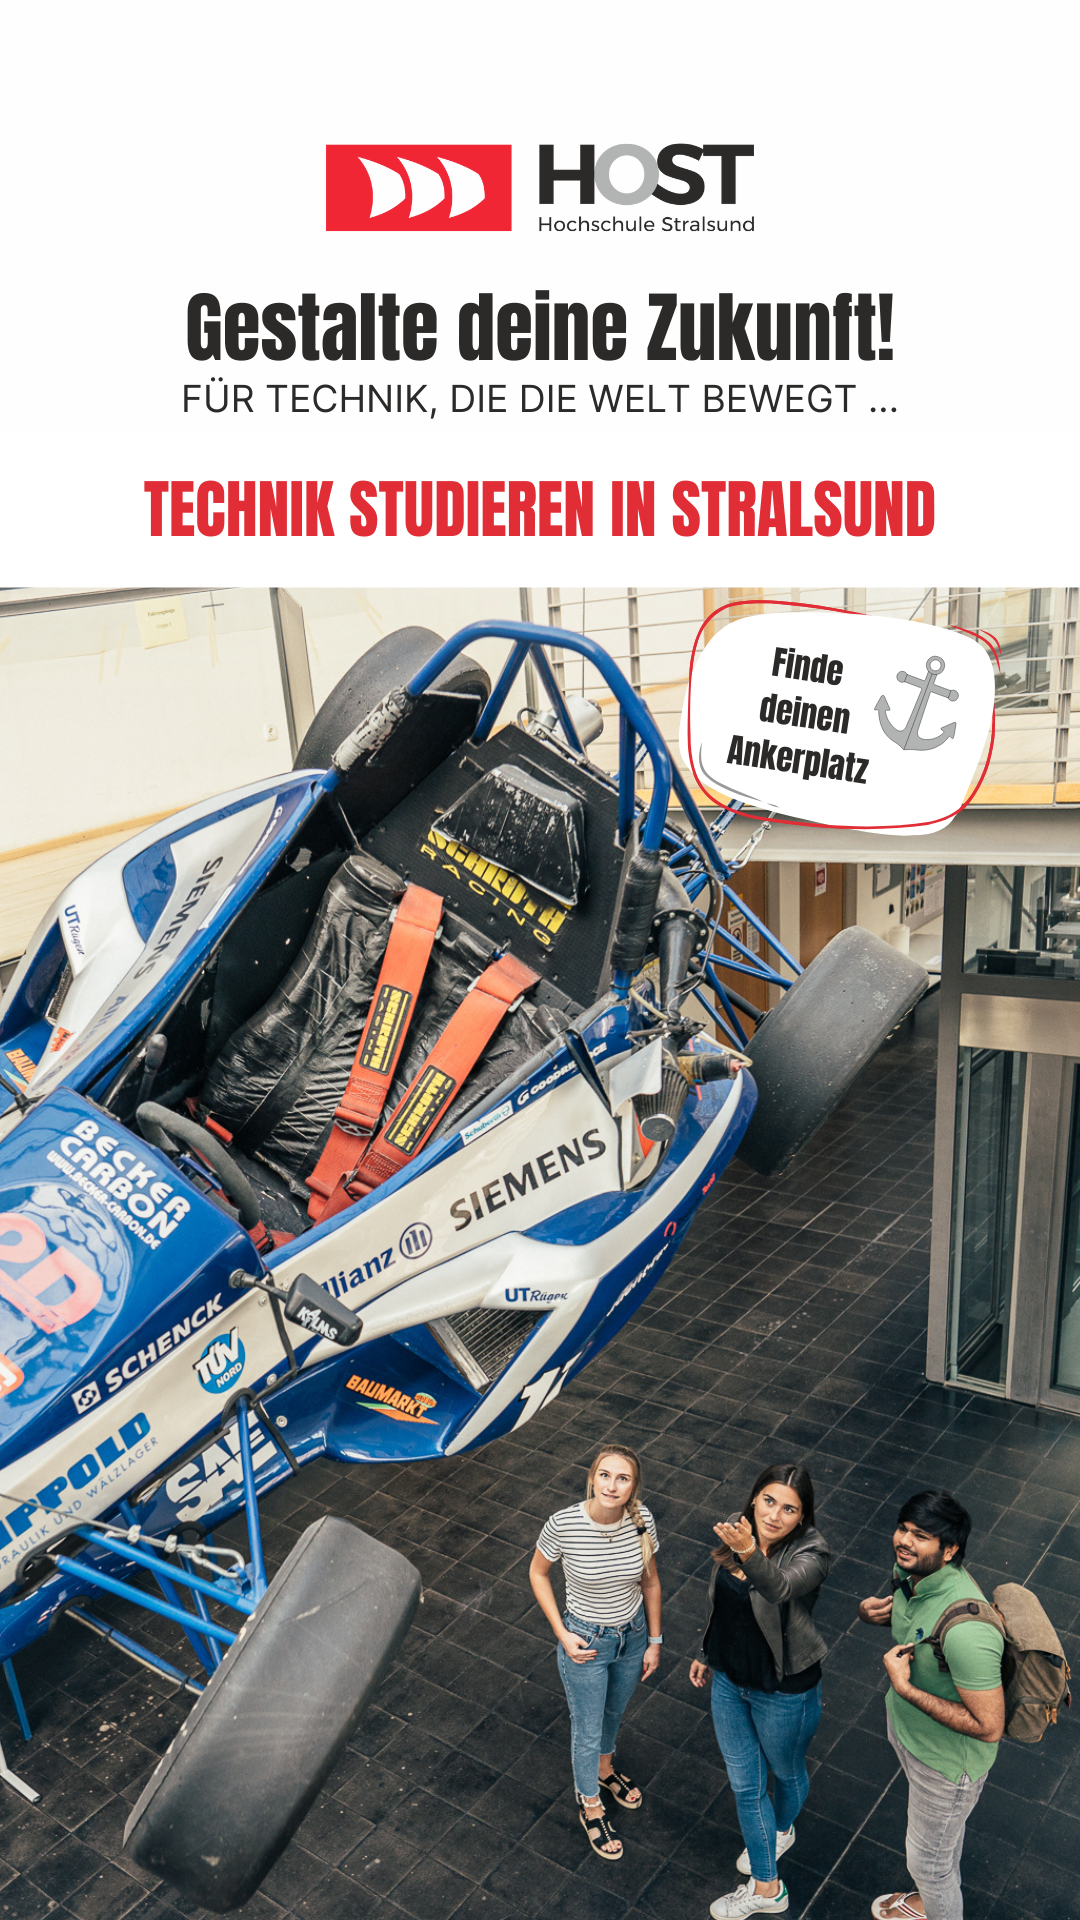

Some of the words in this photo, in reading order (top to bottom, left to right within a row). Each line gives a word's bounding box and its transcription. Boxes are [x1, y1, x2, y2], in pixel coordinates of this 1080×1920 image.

[134, 856, 223, 979] SIEMENS
[420, 844, 551, 946] RACING
[59, 1135, 179, 1239] CARBON
[73, 1119, 191, 1222] BECKER
[449, 1128, 606, 1231] SIEMENS
[105, 1293, 224, 1393] SCHENCK
[216, 1362, 243, 1388] NORD
[345, 1374, 428, 1418] BAUMARKT
[53, 1500, 82, 1525] UND
[86, 1437, 158, 1498] WÄLZLAGER
